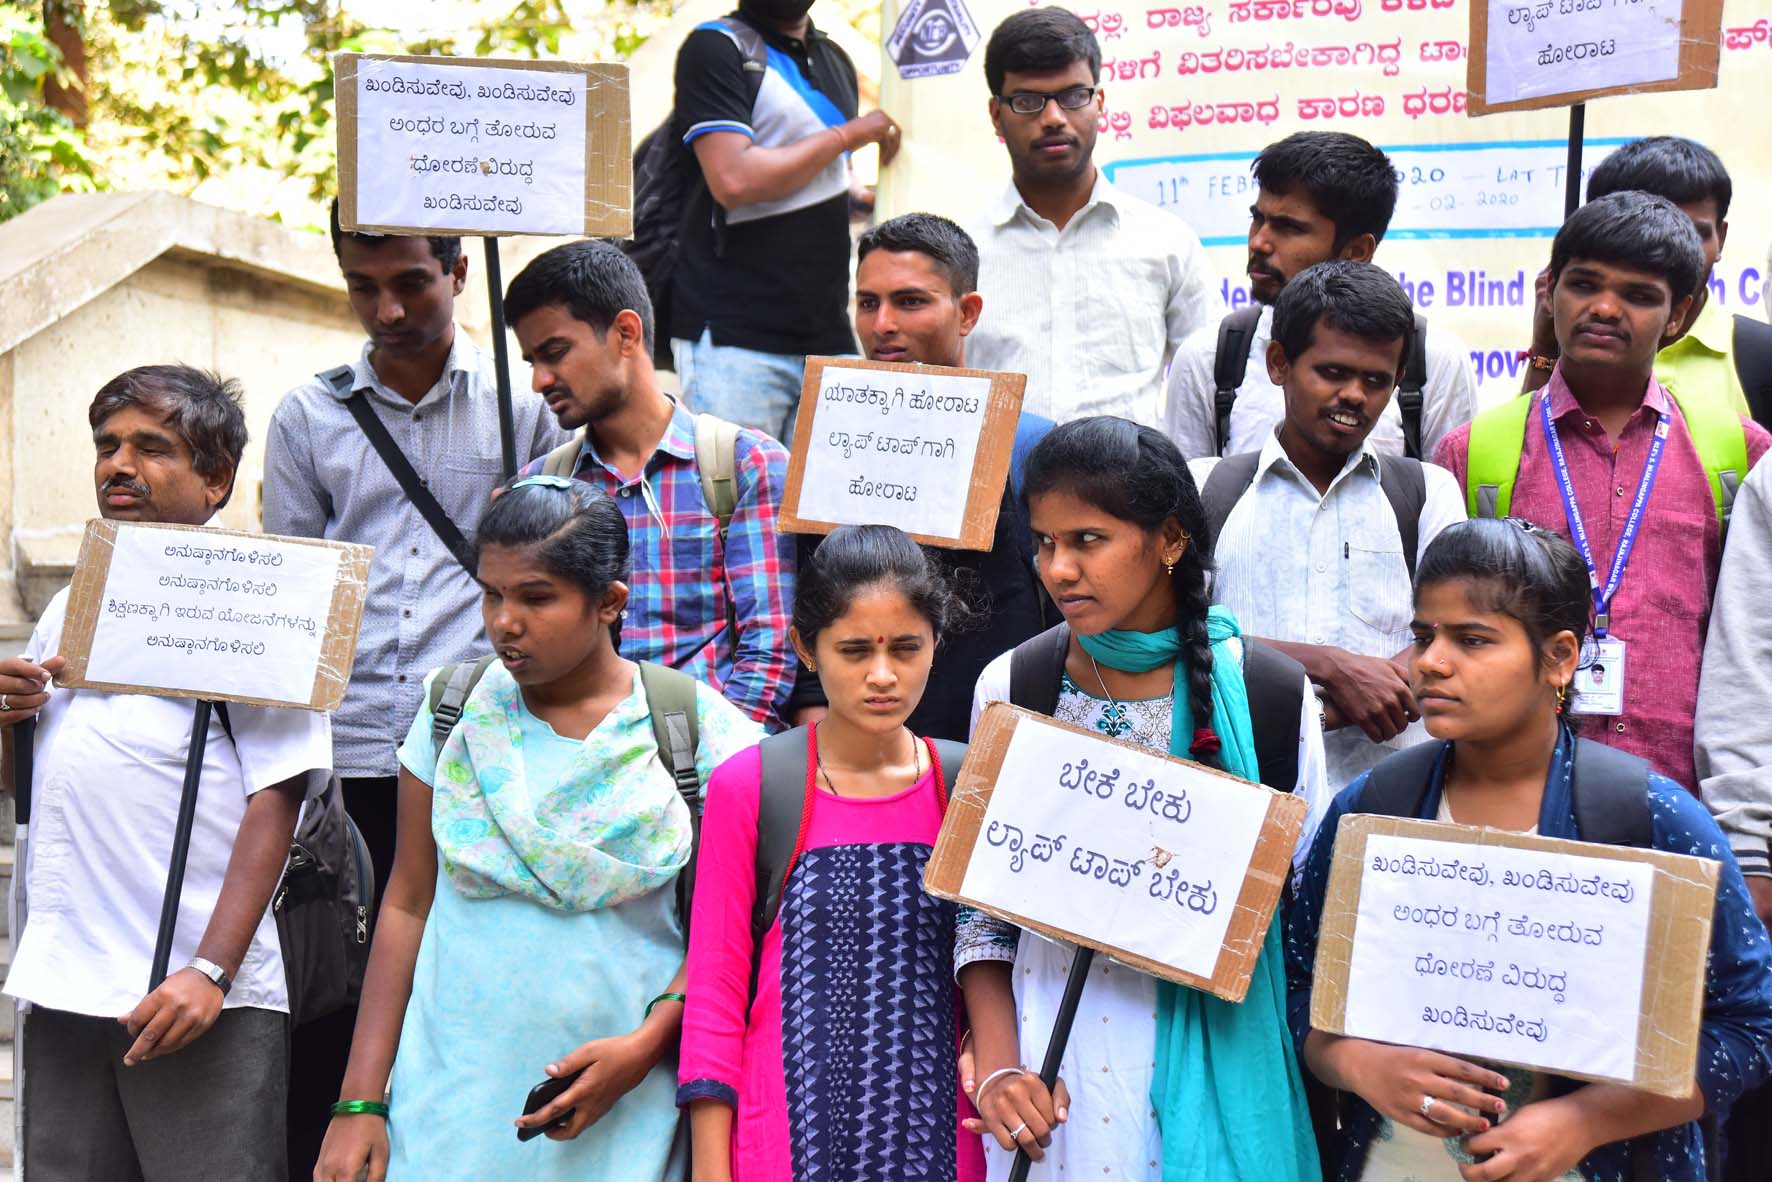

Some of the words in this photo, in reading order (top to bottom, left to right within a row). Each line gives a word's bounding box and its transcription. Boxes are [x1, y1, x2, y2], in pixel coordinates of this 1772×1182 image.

[1146, 5, 1212, 38] ರಾಜ್ಯ
[1508, 2, 1554, 32] ಲ್ಯಾಪ್
[1100, 50, 1161, 82] ಗಳಿಗೆ
[1177, 37, 1401, 77] ವಿತರಿಸಬೇಕಾಗಿದ್ದ
[1538, 39, 1615, 66] ಹೋರಾಟ
[366, 77, 471, 99] ಖಂಡಿಸುವೇವು,
[477, 83, 575, 105] ಖಂಡಿಸುವೇವು
[1297, 89, 1384, 120] ಕಾರಣ
[390, 116, 444, 135] ಅಂಧರ
[450, 119, 479, 142] ಬಗ್ಗೆ
[485, 120, 556, 139] ತೋರುವ
[413, 155, 478, 174] ಧೋರಣೆ
[487, 158, 533, 185] ವಿರುದ್ಧ
[424, 194, 522, 215] ಖಂಡಿಸುವೇವು
[1446, 270, 1525, 306] Blind
[825, 383, 904, 415] ಯಾತಕ್ಕಾಗಿ
[909, 390, 978, 413] ಹೋರಾಟ
[829, 432, 874, 459] ಲ್ಯಾಪ್
[849, 475, 917, 501] ಹೋರಾಟ
[165, 544, 282, 566] ಅನುಷ್ಠಾನಗೊಳಿಸಲಿ
[159, 574, 277, 596] ಅನುಷ್ಠಾನಗೊಳಿಸಲಿ
[108, 599, 170, 621] ಶಿಕ್ಷಣಕ್ಕಾಗಿ
[175, 606, 214, 620] ಇರುವ
[218, 608, 316, 636] ಯೋಜನೆಗಳನ್ನು
[147, 634, 265, 655] ಅನುಷ್ಠಾನಗೊಳಿಸಲಿ
[1059, 759, 1120, 799] ಬೇಕೆ
[1125, 779, 1191, 823] ಬೇಕು
[987, 821, 1067, 873] ಲ್ಯಾಪ್
[1070, 847, 1148, 887] ಟಾಪ್
[1149, 867, 1217, 915] ಬೇಕು
[1372, 855, 1494, 886] ಖಂಡಿಸುವೇವು,
[1503, 870, 1634, 903] ಖಂಡಿಸುವೇವು
[1394, 905, 1458, 928] ಅಂಧರ
[1465, 912, 1500, 942] ಬಗ್ಗೆ
[1508, 915, 1603, 945] ತೋರುವ
[1415, 953, 1494, 981] ಧೋರಣೆ
[1502, 964, 1566, 1004] ವಿರುದ್ಧ
[1422, 1006, 1547, 1042] ಖಂಡಿಸುವೇವು
